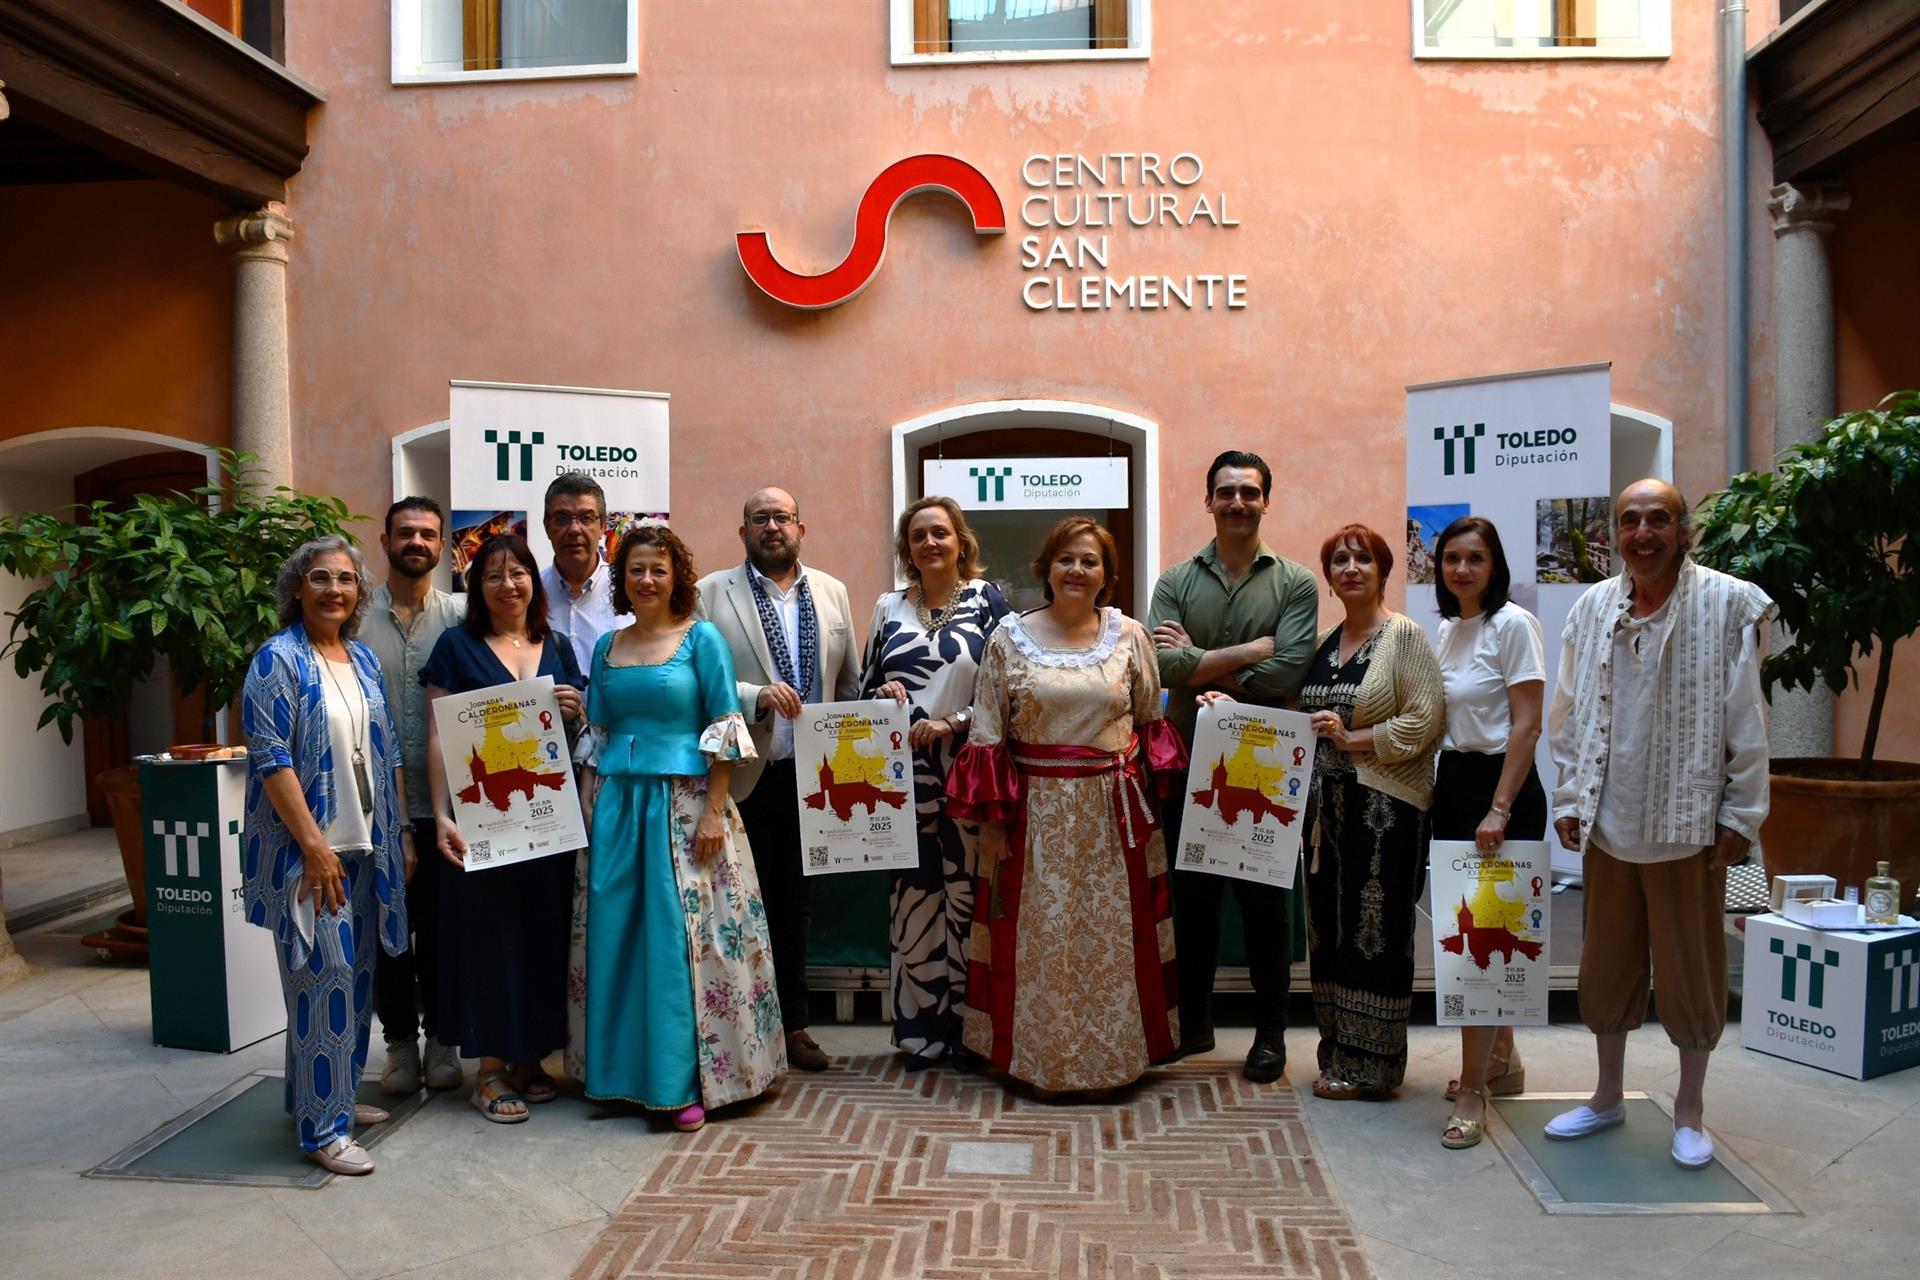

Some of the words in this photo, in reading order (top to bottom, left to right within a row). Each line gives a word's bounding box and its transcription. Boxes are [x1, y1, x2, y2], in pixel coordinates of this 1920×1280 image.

[1022, 152, 1204, 188] CENTRO
[1021, 193, 1241, 227] CULTURAL
[1022, 235, 1109, 269] SAN
[1022, 274, 1248, 310] CLEMENTE
[1497, 427, 1577, 449] TOLEDO
[557, 444, 638, 463] TOLEDO
[1495, 449, 1578, 467] Diputación
[1020, 474, 1082, 487] TOLEDO
[1023, 488, 1081, 499] Diputación
[457, 698, 537, 723] CALDERONIANAS
[466, 697, 504, 711] JORNADAS
[822, 712, 860, 722] JORNADAS
[1228, 712, 1267, 724] JORNADAS
[813, 718, 890, 733] CALDERONIANAS
[1217, 718, 1297, 739] CALDERONIANAS
[530, 804, 554, 818] 2025
[869, 821, 892, 831] 2025
[1251, 832, 1275, 844] 2025
[1452, 859, 1532, 871] CALDERONIANAS
[156, 887, 213, 903] TOLEDO
[157, 902, 213, 915] Diputación
[1504, 973, 1526, 983] 2025
[1767, 1010, 1837, 1039] TOLEDO
[1766, 1025, 1836, 1054] Diputación
